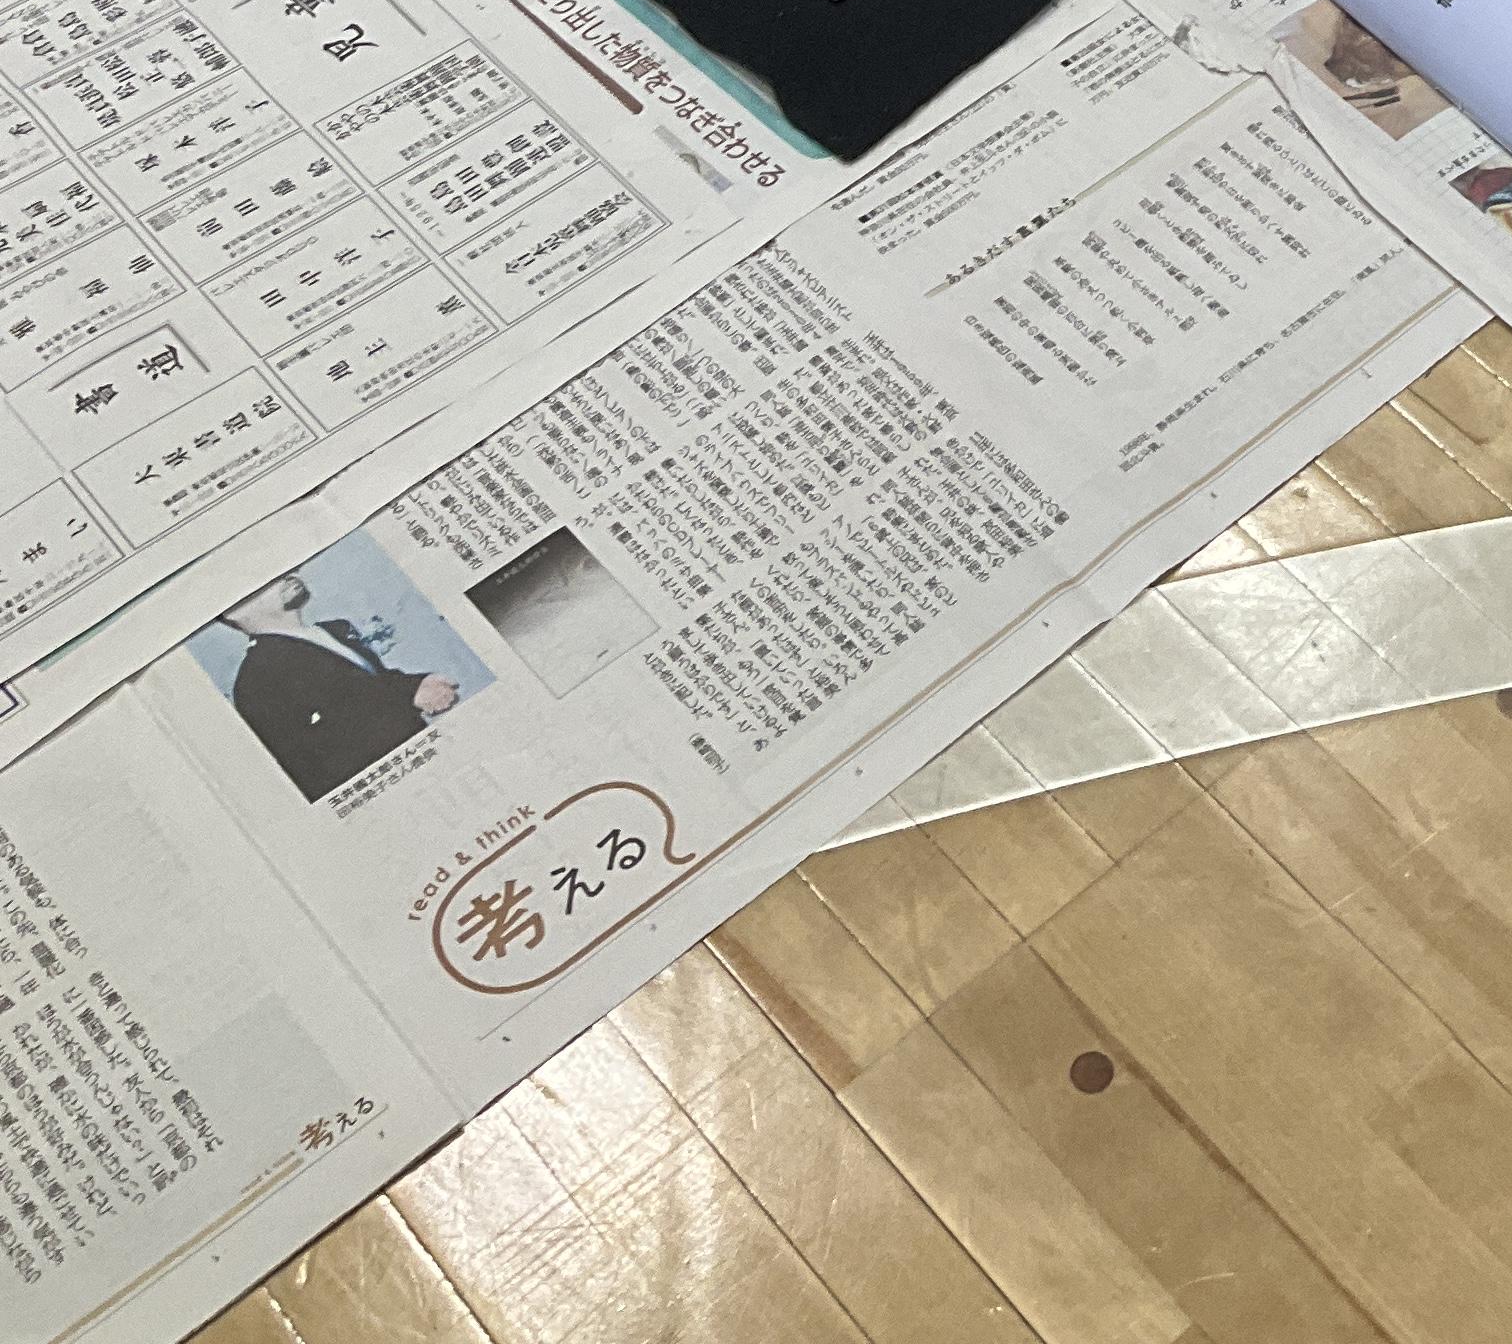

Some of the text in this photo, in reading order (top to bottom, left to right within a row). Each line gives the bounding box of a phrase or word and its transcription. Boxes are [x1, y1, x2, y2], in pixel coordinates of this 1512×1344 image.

[259, 221, 396, 309] 田中洋子
[504, 185, 633, 274] 全日本児童舞踊協会
[74, 344, 184, 416] 書道
[134, 389, 282, 485] 大東書道院
[409, 804, 537, 921] read & think
[456, 828, 649, 962] 考える
[300, 1096, 375, 1152] 考える
